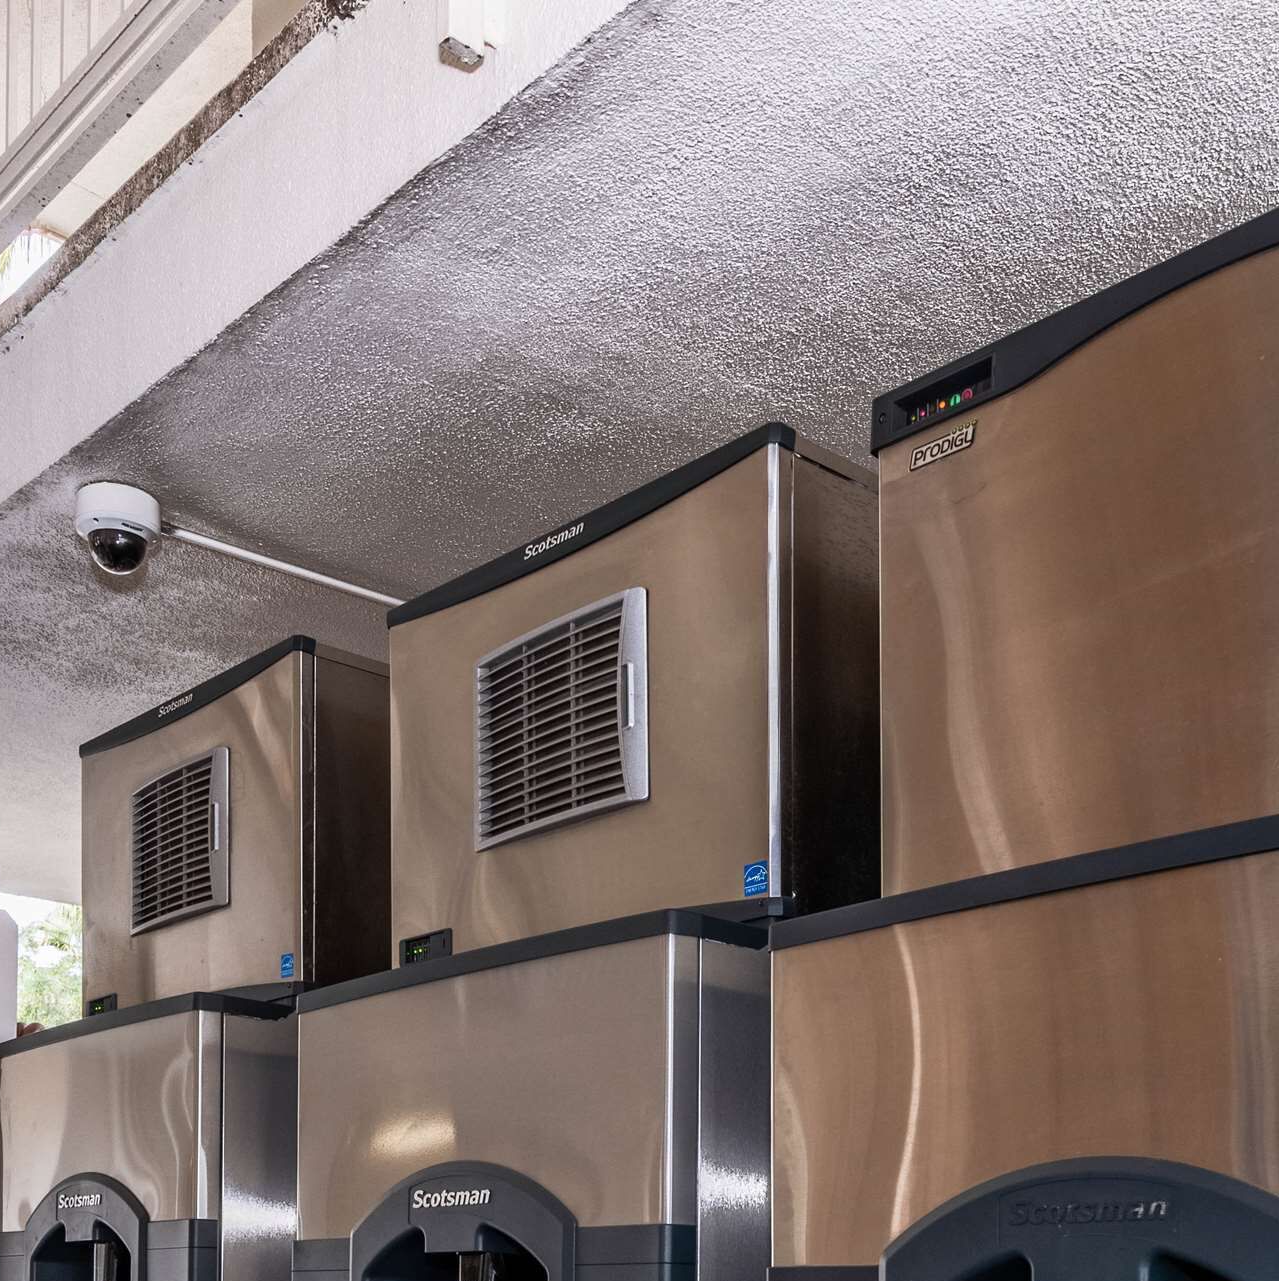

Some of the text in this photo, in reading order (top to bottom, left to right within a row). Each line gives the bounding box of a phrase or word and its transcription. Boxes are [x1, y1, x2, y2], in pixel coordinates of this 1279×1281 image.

[523, 521, 585, 561] Scotsman
[158, 693, 193, 718] Scotsman
[57, 1193, 101, 1209] Scotsman
[412, 1188, 491, 1209] Scotsman
[1008, 1199, 1168, 1227] Scotsman
